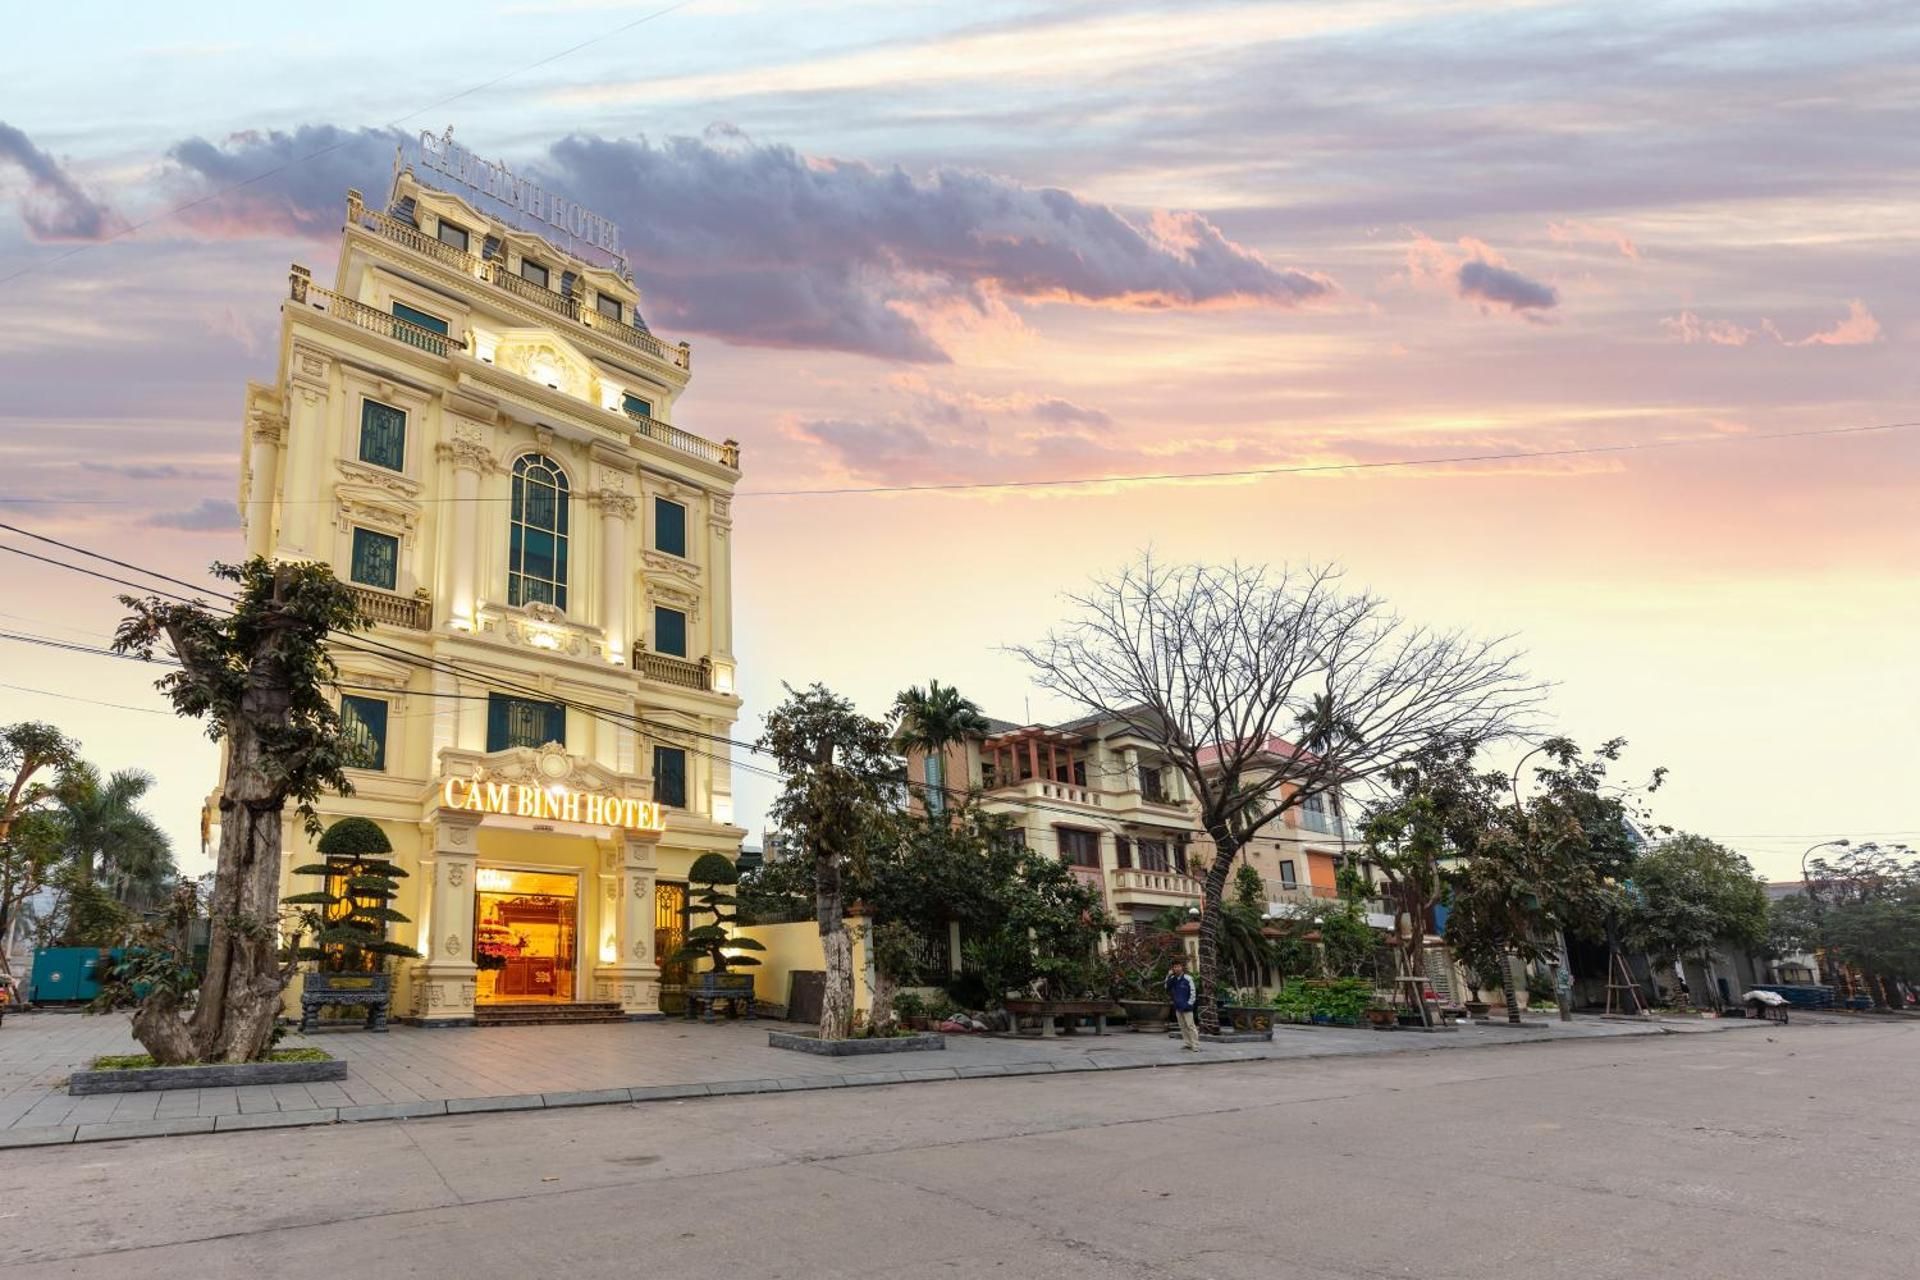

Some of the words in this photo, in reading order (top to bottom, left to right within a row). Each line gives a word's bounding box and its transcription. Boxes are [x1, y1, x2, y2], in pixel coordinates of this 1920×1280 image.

[551, 192, 622, 255] HOTEL
[445, 766, 510, 814] CẨM
[517, 780, 580, 822] BÌNH
[586, 795, 667, 831] HOTEL
